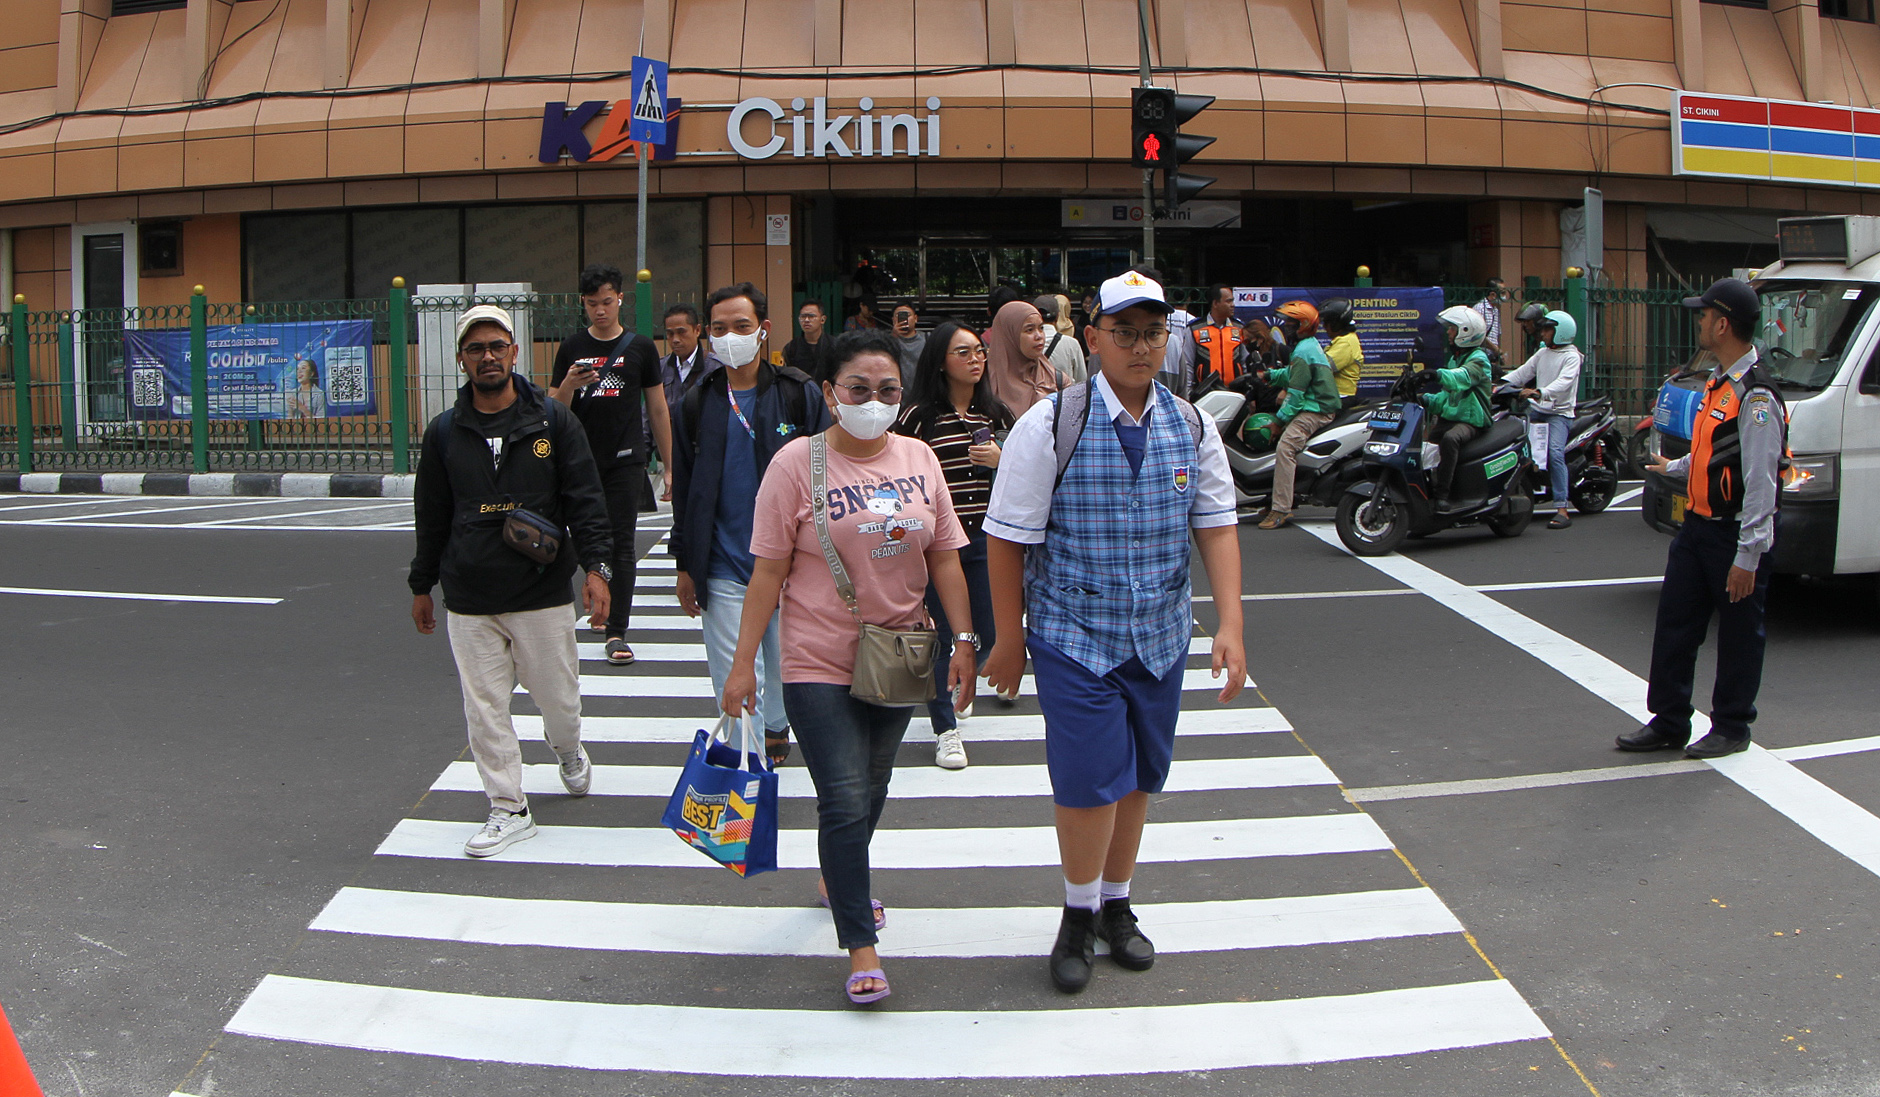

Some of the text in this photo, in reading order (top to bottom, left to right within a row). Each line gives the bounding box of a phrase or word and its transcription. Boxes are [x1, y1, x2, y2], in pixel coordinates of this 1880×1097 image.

[1683, 106, 1720, 117] ST. CIKINI
[538, 95, 942, 164] KAI Cikini
[1073, 209, 1079, 217] A
[1239, 293, 1256, 302] KAI
[1353, 298, 1398, 308] PENTING
[1374, 311, 1398, 319] Stasiun
[1399, 311, 1418, 319] Cikini
[1377, 411, 1391, 419] 4202
[813, 440, 824, 474] GUESS
[814, 484, 824, 524] GUSS
[901, 518, 917, 526] LOVE
[820, 534, 842, 575] GUESS
[871, 543, 910, 560] PEANUTS
[684, 796, 725, 828] BEST
